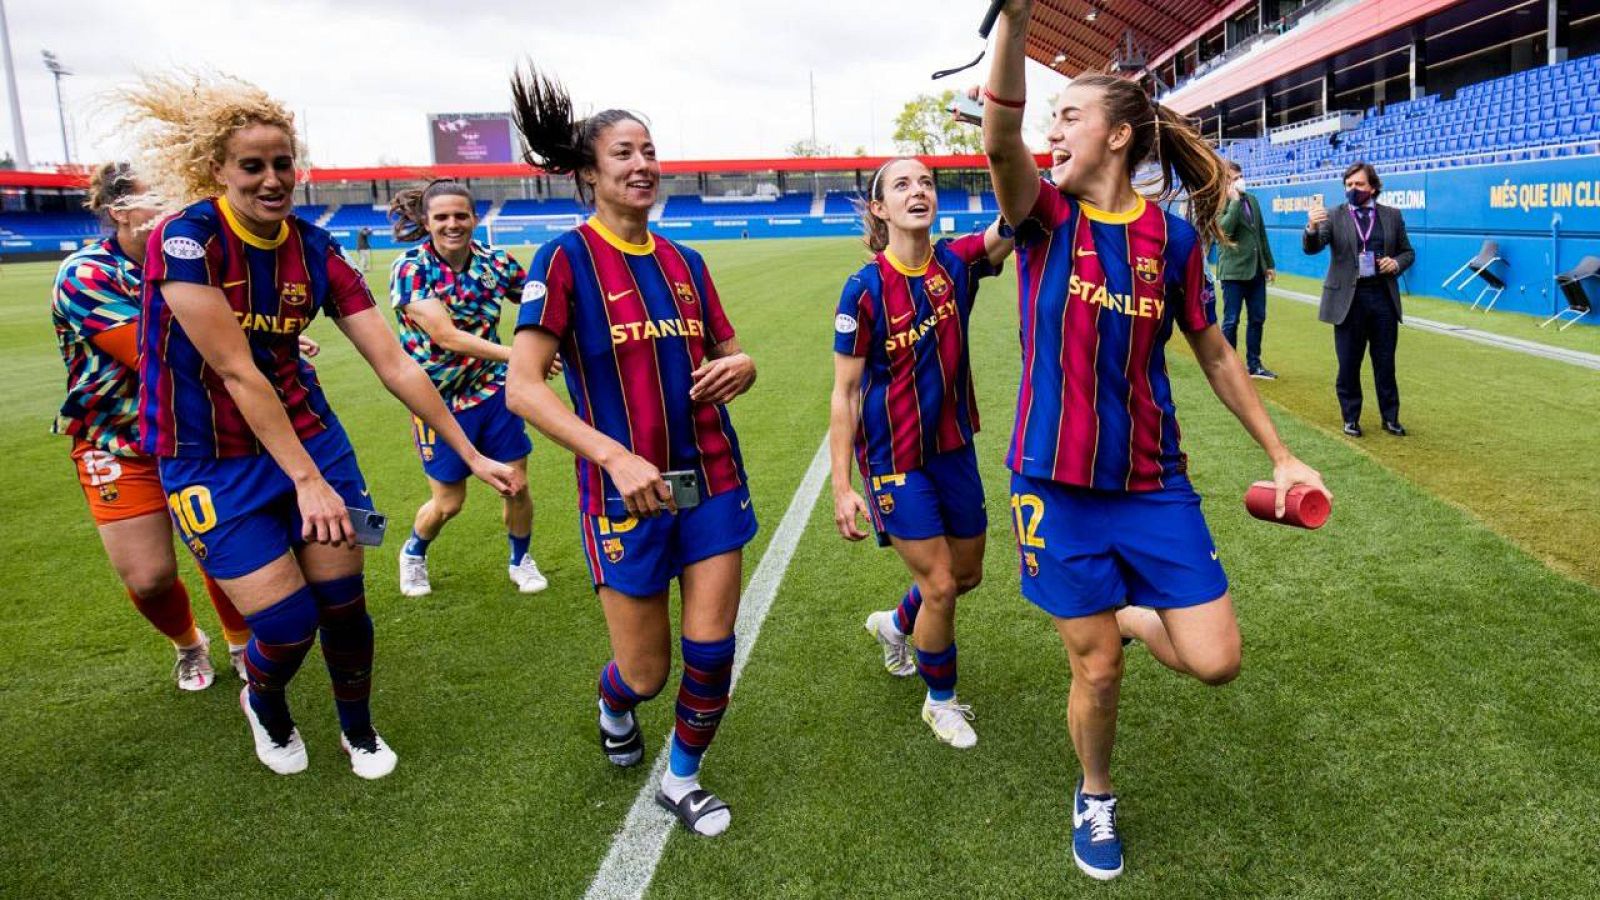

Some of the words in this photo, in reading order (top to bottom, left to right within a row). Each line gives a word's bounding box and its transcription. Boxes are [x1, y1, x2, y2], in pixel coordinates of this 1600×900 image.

[1491, 179, 1517, 208] MÉS
[1520, 183, 1548, 212] QUE
[1550, 182, 1572, 207] UN
[1069, 274, 1165, 320] STANLEY
[233, 311, 309, 335] ANLEY
[611, 318, 705, 345] STANLEY
[168, 484, 217, 539] 10
[1011, 492, 1046, 549] 12
